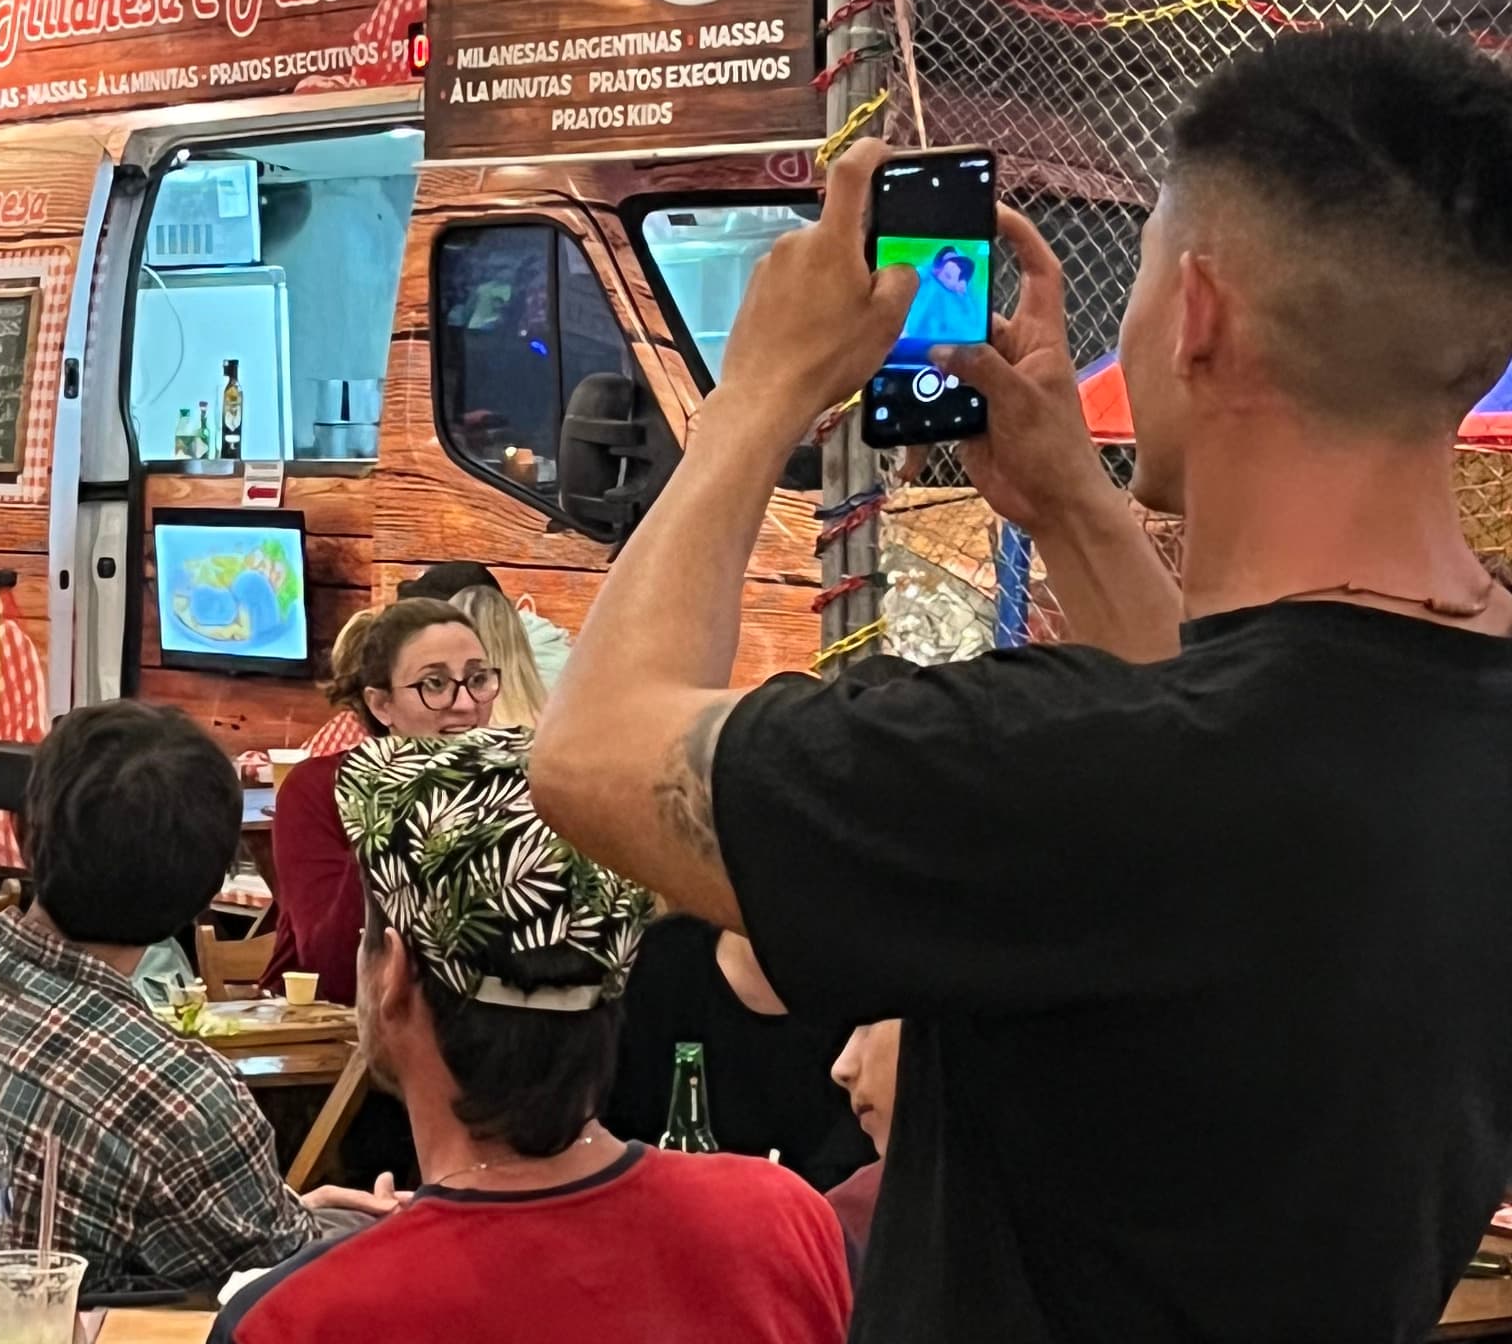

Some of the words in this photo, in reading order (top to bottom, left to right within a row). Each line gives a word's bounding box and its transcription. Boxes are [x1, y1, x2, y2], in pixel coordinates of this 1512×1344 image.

[457, 40, 560, 70] MILANESAS
[562, 29, 682, 63] ARGENTINAS
[699, 19, 785, 49] MASSAS
[27, 79, 88, 105] MASSAS
[109, 74, 129, 96] LA
[130, 66, 199, 93] MINUTAS
[209, 58, 272, 86] PRATOS
[275, 41, 378, 77] EXECUTIVOS
[466, 81, 490, 103] LA
[492, 74, 573, 100] MINUTAS
[589, 67, 663, 94] PRATOS
[665, 56, 791, 89] EXECUTIVOS
[552, 105, 625, 131] PRATOS
[627, 102, 673, 127] KIDS
